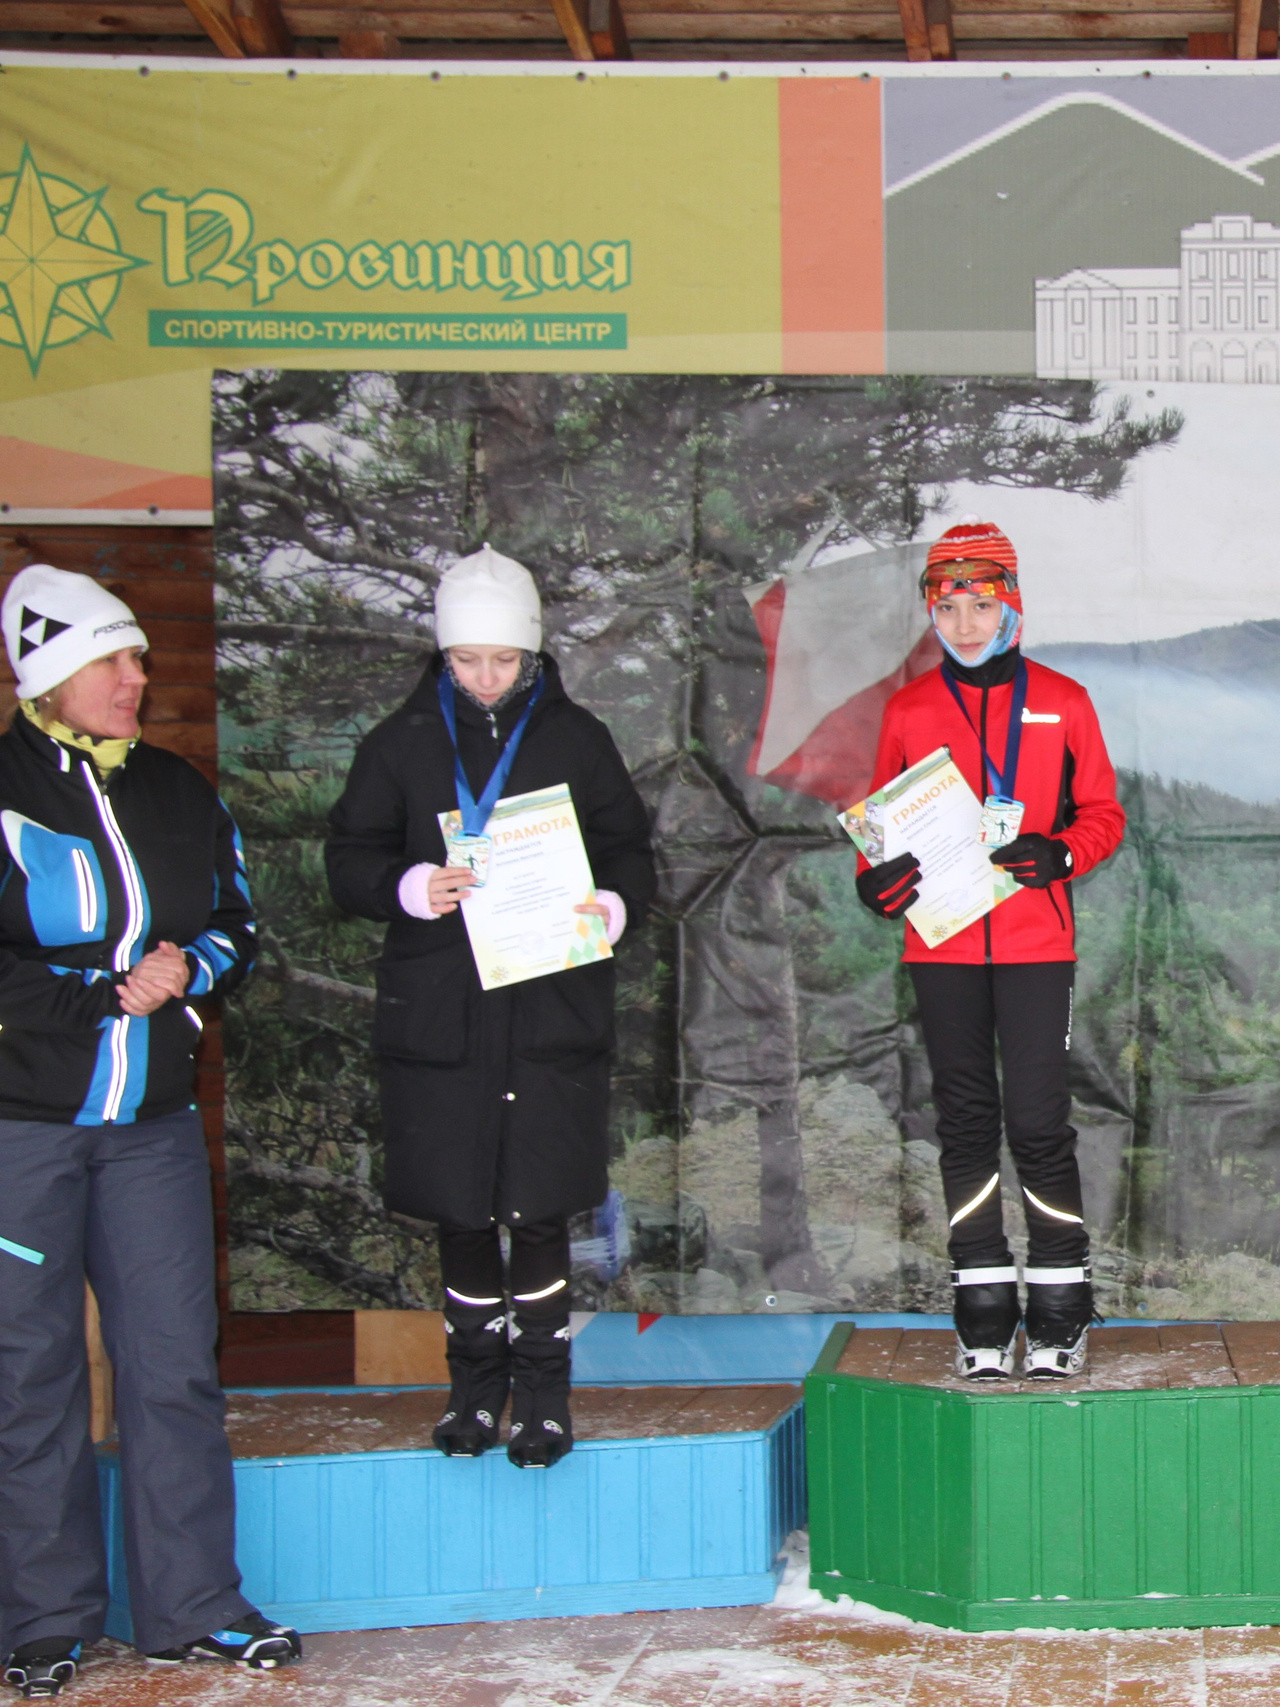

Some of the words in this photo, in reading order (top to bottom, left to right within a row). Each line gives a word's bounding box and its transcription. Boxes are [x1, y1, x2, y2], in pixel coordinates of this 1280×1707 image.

[137, 188, 631, 306] Провинция
[164, 318, 527, 342] СПОРТИВНО-ТУРИСТИЧЕСКИЙ
[533, 321, 612, 344] ЦЕНТР
[891, 774, 959, 826] ГРАМОТА
[492, 816, 572, 847] ГРАМОТА
